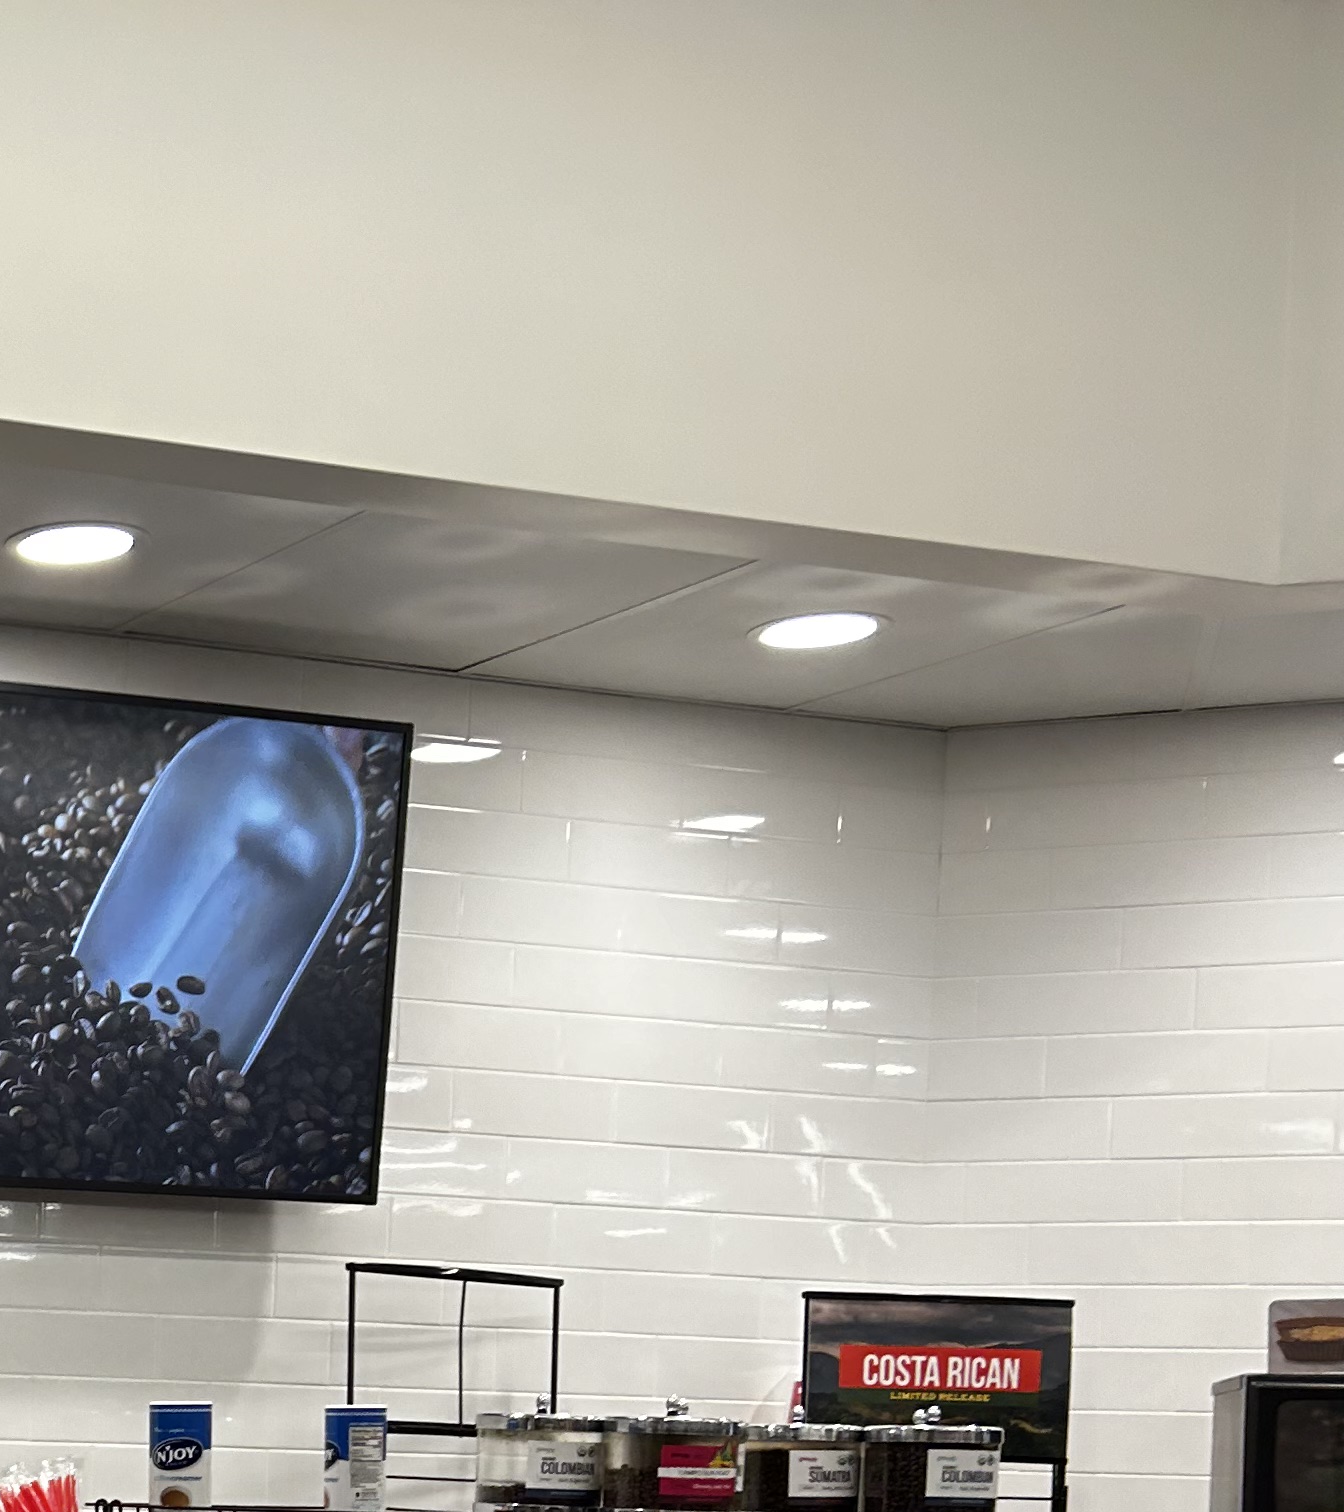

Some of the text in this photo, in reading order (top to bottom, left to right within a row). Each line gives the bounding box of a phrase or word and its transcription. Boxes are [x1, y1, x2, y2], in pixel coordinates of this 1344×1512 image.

[863, 1354, 1020, 1389] COSTA RICAN
[890, 1391, 991, 1402] LIMITED RELEASE
